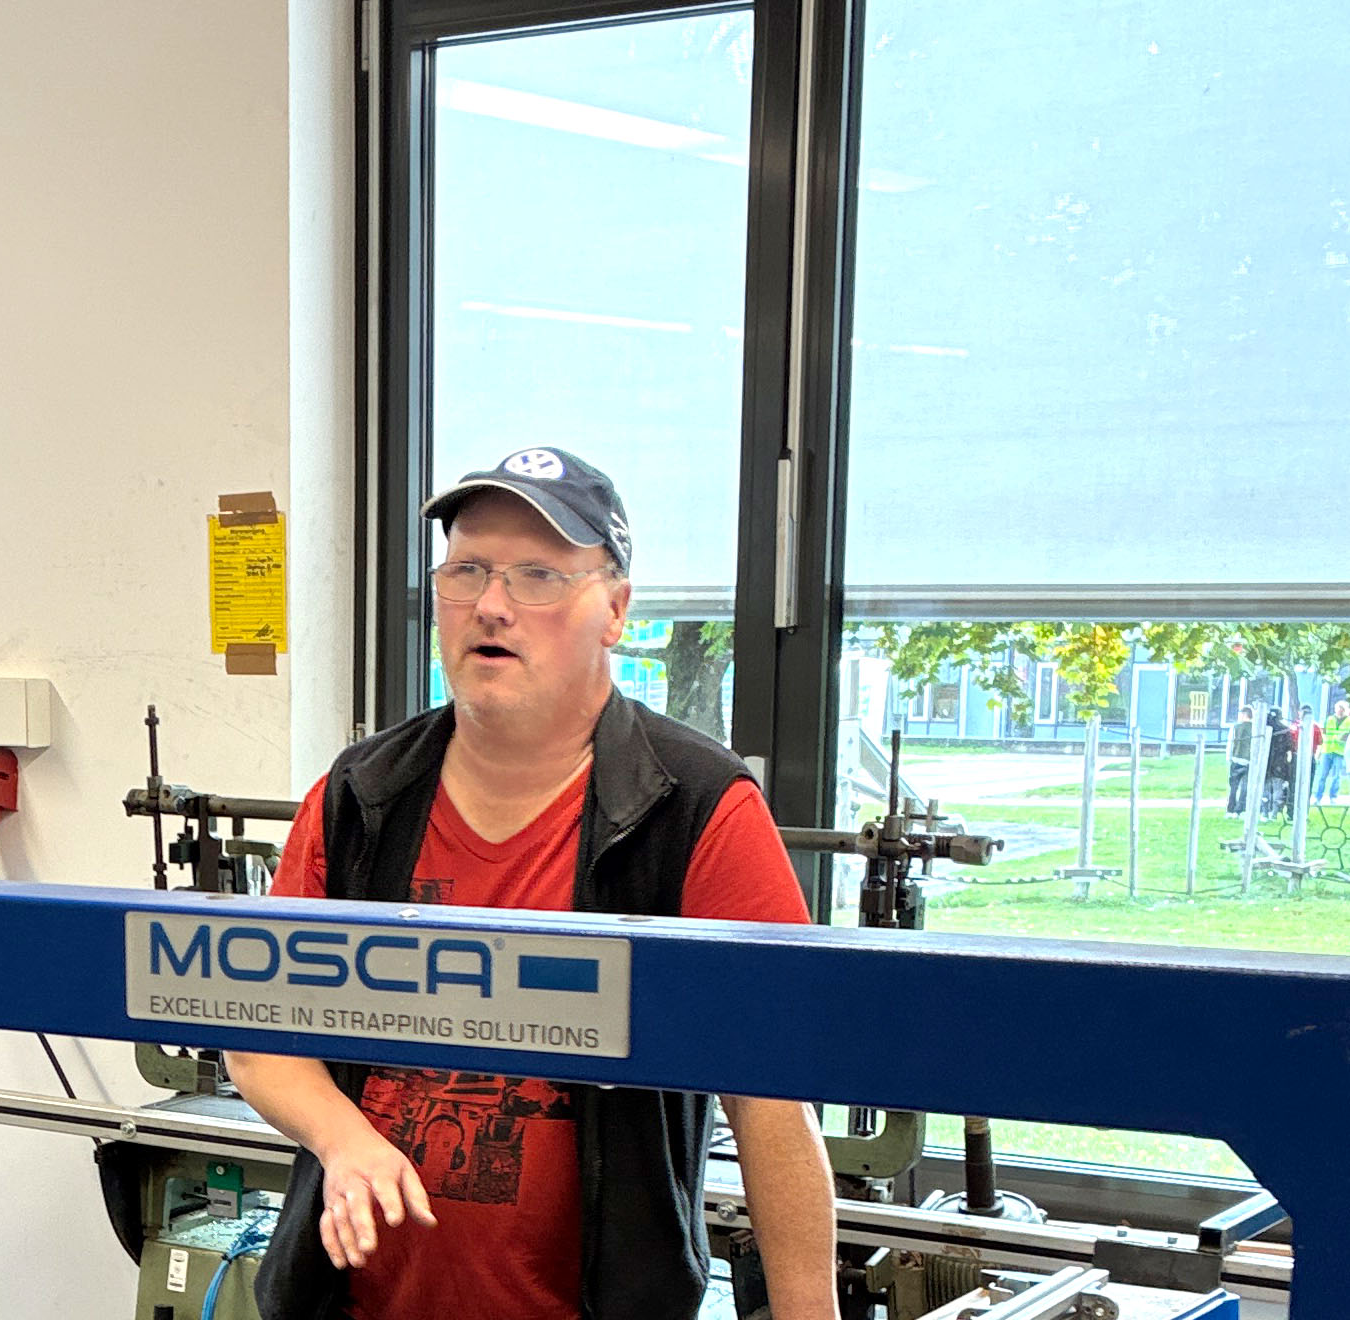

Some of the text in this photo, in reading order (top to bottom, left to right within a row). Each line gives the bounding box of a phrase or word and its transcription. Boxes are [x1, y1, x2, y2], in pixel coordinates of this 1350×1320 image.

[150, 921, 492, 998] MOSCA
[150, 995, 599, 1048] EXCELLENCE IN STRAPPING SOLUTIONS
